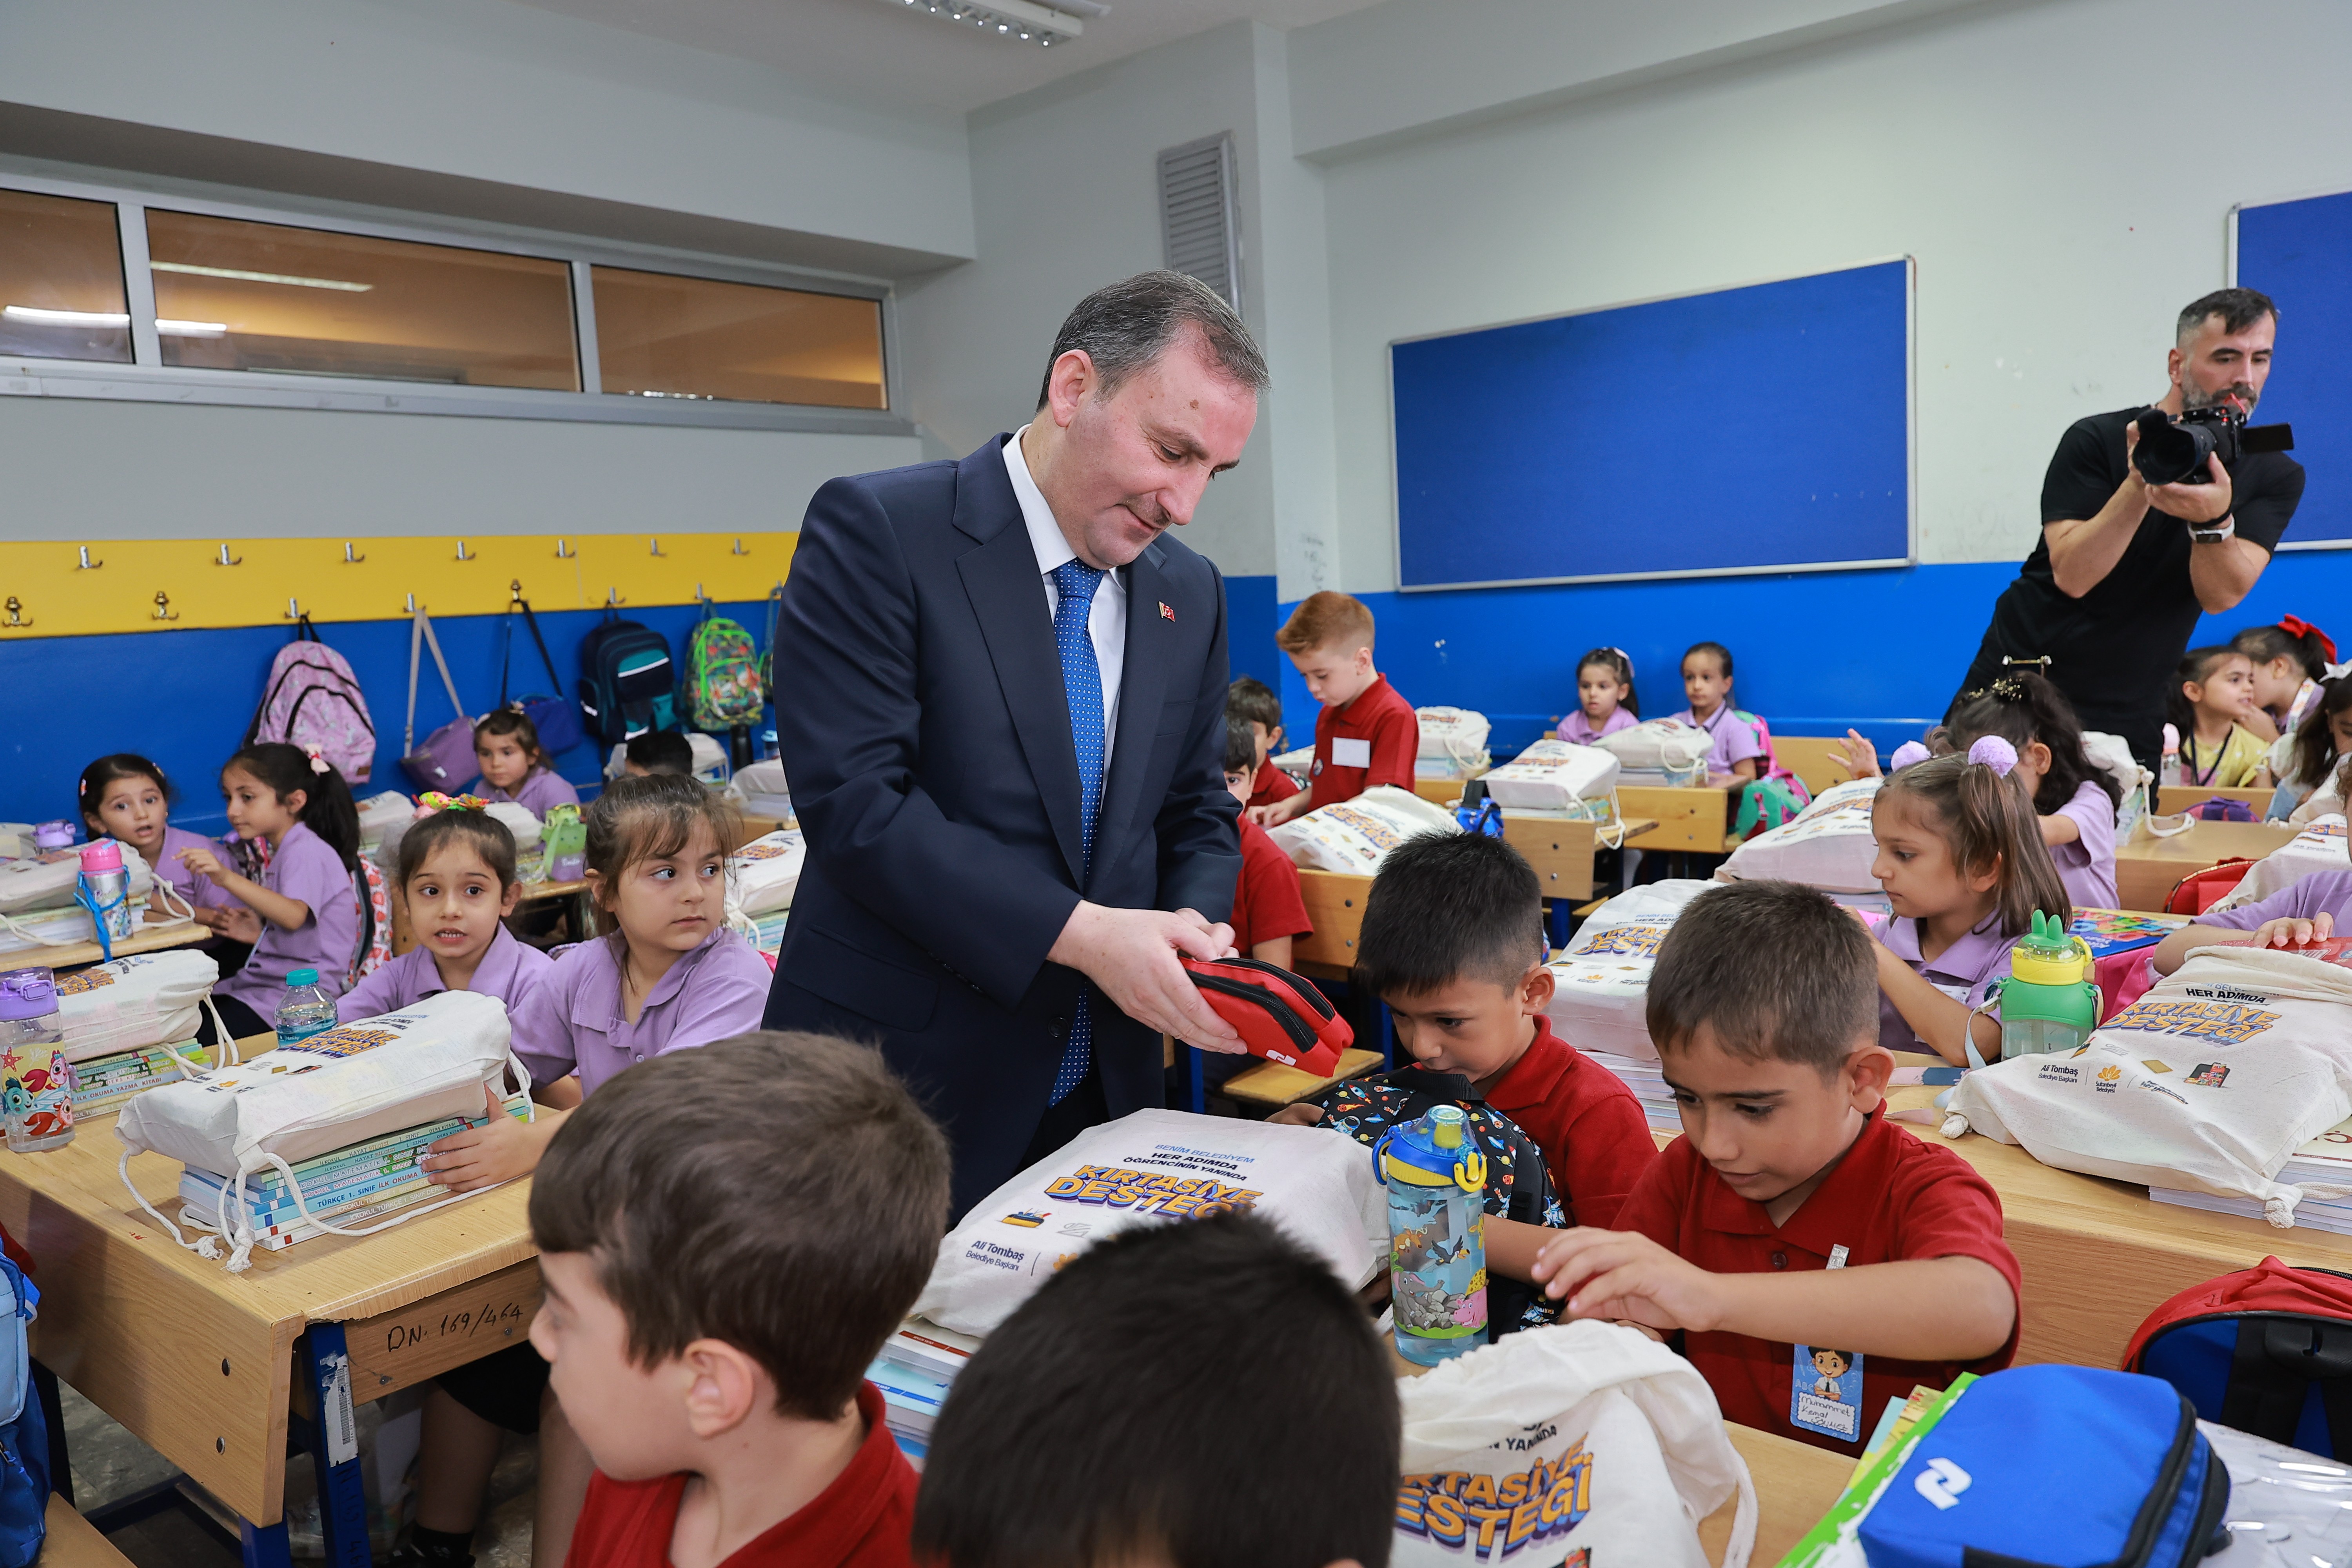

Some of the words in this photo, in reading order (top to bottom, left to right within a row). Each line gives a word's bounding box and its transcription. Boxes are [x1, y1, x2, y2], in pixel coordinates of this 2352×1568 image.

[2186, 988, 2213, 998] HER
[2217, 991, 2267, 1003] ADIMDA
[2123, 1002, 2283, 1025] KIRTASİYE
[2098, 1014, 2273, 1046] DESTEĞİ
[2051, 1065, 2078, 1077] Tombaş
[90, 1089, 114, 1098] OKUMA
[116, 1083, 138, 1092] YAZMA
[142, 1077, 162, 1086] KİTABI
[319, 1156, 341, 1165] İLKOKUL
[349, 1147, 367, 1157] HAYAT
[368, 1140, 390, 1151] BİLGİSİ
[441, 1122, 456, 1130] KİTABI
[1154, 1144, 1191, 1154] BENİM
[1190, 1148, 1256, 1163] BELEDİYEM
[300, 1176, 330, 1189] KOKUL
[333, 1159, 381, 1179] MATEMATİK
[393, 1149, 414, 1161] SINIF
[325, 1163, 346, 1172] İLKOKUL
[354, 1154, 374, 1163] HAYAT
[1123, 1156, 1198, 1170] ÖĞRENCİNİN
[1200, 1166, 1248, 1181] YANINDA
[1184, 1156, 1239, 1171] ADIMDA
[303, 1186, 331, 1199] KOKUL
[334, 1169, 381, 1189] MATEMATİK
[392, 1159, 413, 1171] SINIF
[317, 1194, 345, 1208] TÜRKÇE
[358, 1185, 376, 1195] SINIF
[378, 1180, 390, 1189] İLK
[392, 1172, 418, 1184] OKUMA
[1073, 1164, 1265, 1204] KIRTASİYE
[337, 1200, 365, 1214] İLKOKUL
[366, 1191, 391, 1205] TÜRKÇE
[399, 1183, 415, 1193] SINIF
[350, 1208, 377, 1221] İLKOKUL
[377, 1198, 403, 1212] TÜRKÇE
[410, 1191, 426, 1202] SINIF
[426, 1186, 443, 1196] DERS
[965, 1250, 995, 1265] Belediye
[994, 1258, 1020, 1271] Başkanı
[971, 1240, 987, 1250] Ali
[987, 1242, 1025, 1263] Tombaş
[1394, 1452, 1593, 1559] ESTEĞİ
